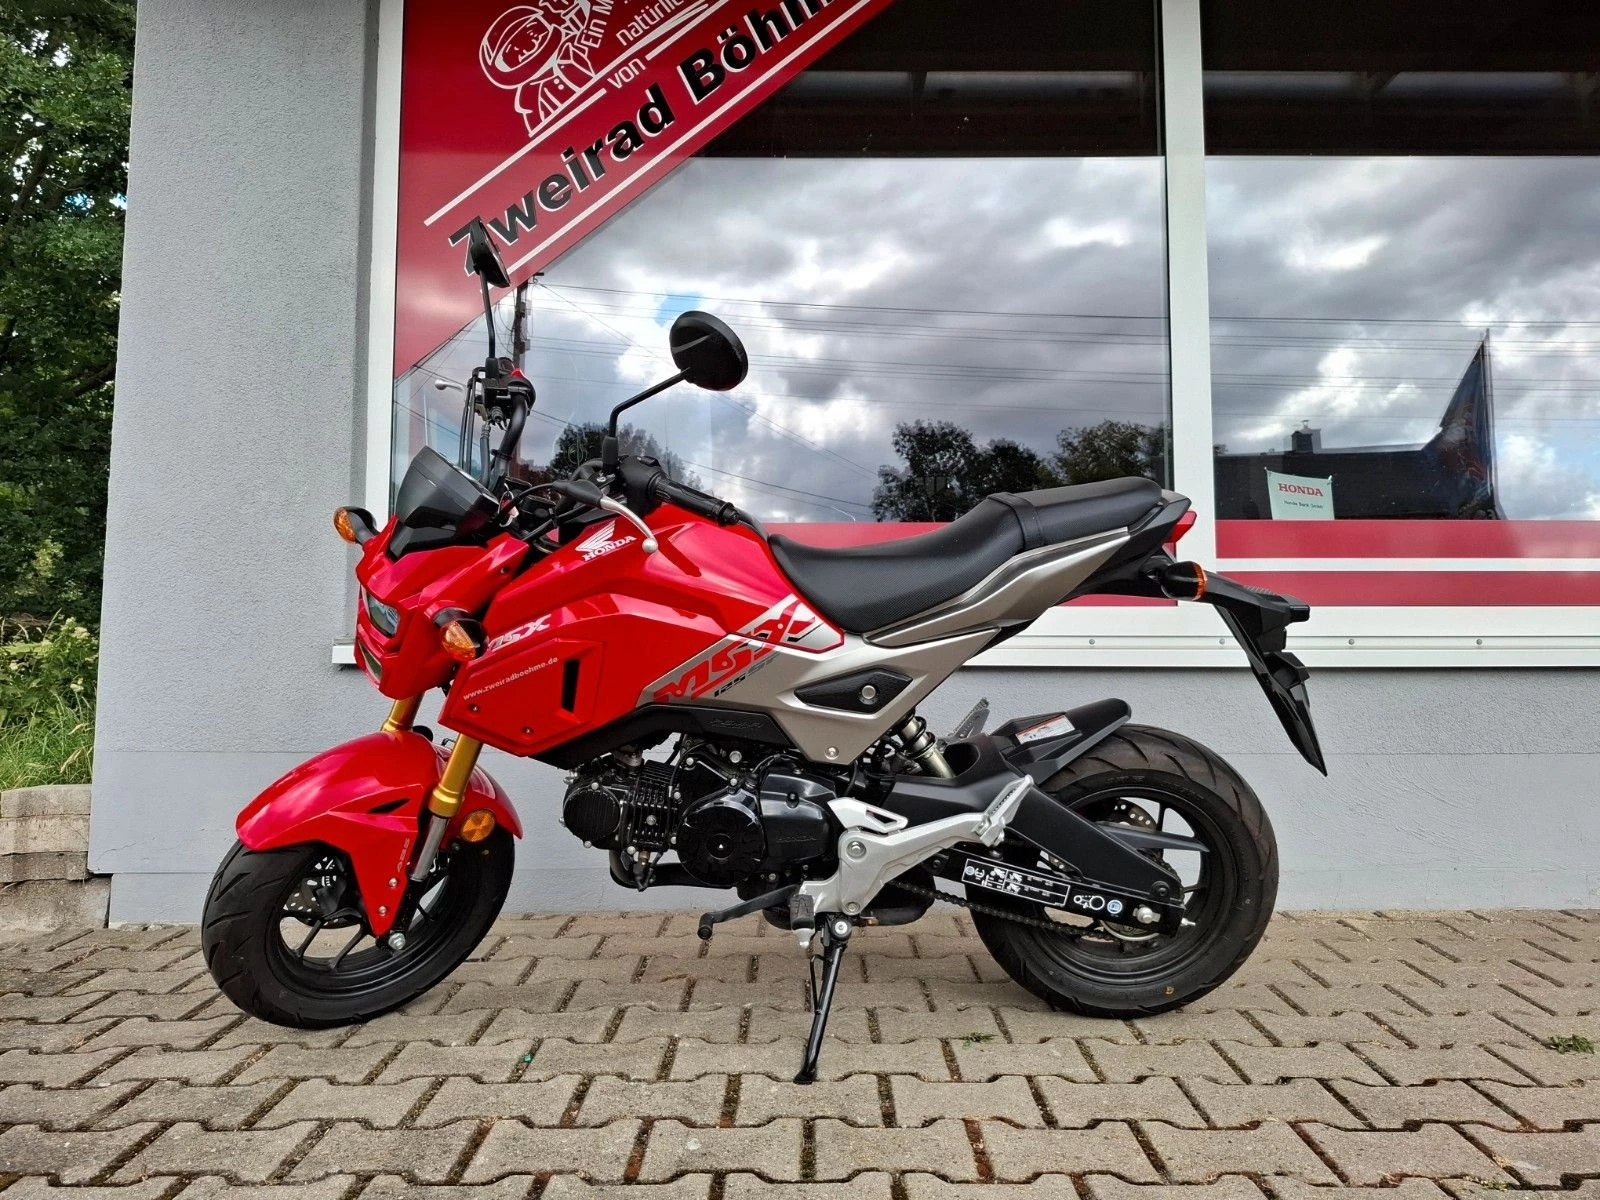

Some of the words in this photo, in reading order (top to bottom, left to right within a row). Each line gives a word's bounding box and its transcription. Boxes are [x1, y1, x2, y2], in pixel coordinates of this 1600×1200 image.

[580, 19, 607, 48] Ein
[607, 58, 646, 89] von
[1278, 483, 1324, 497] HONDA
[582, 535, 637, 561] HONDA
[463, 656, 559, 701] www.zweiradboehme.de
